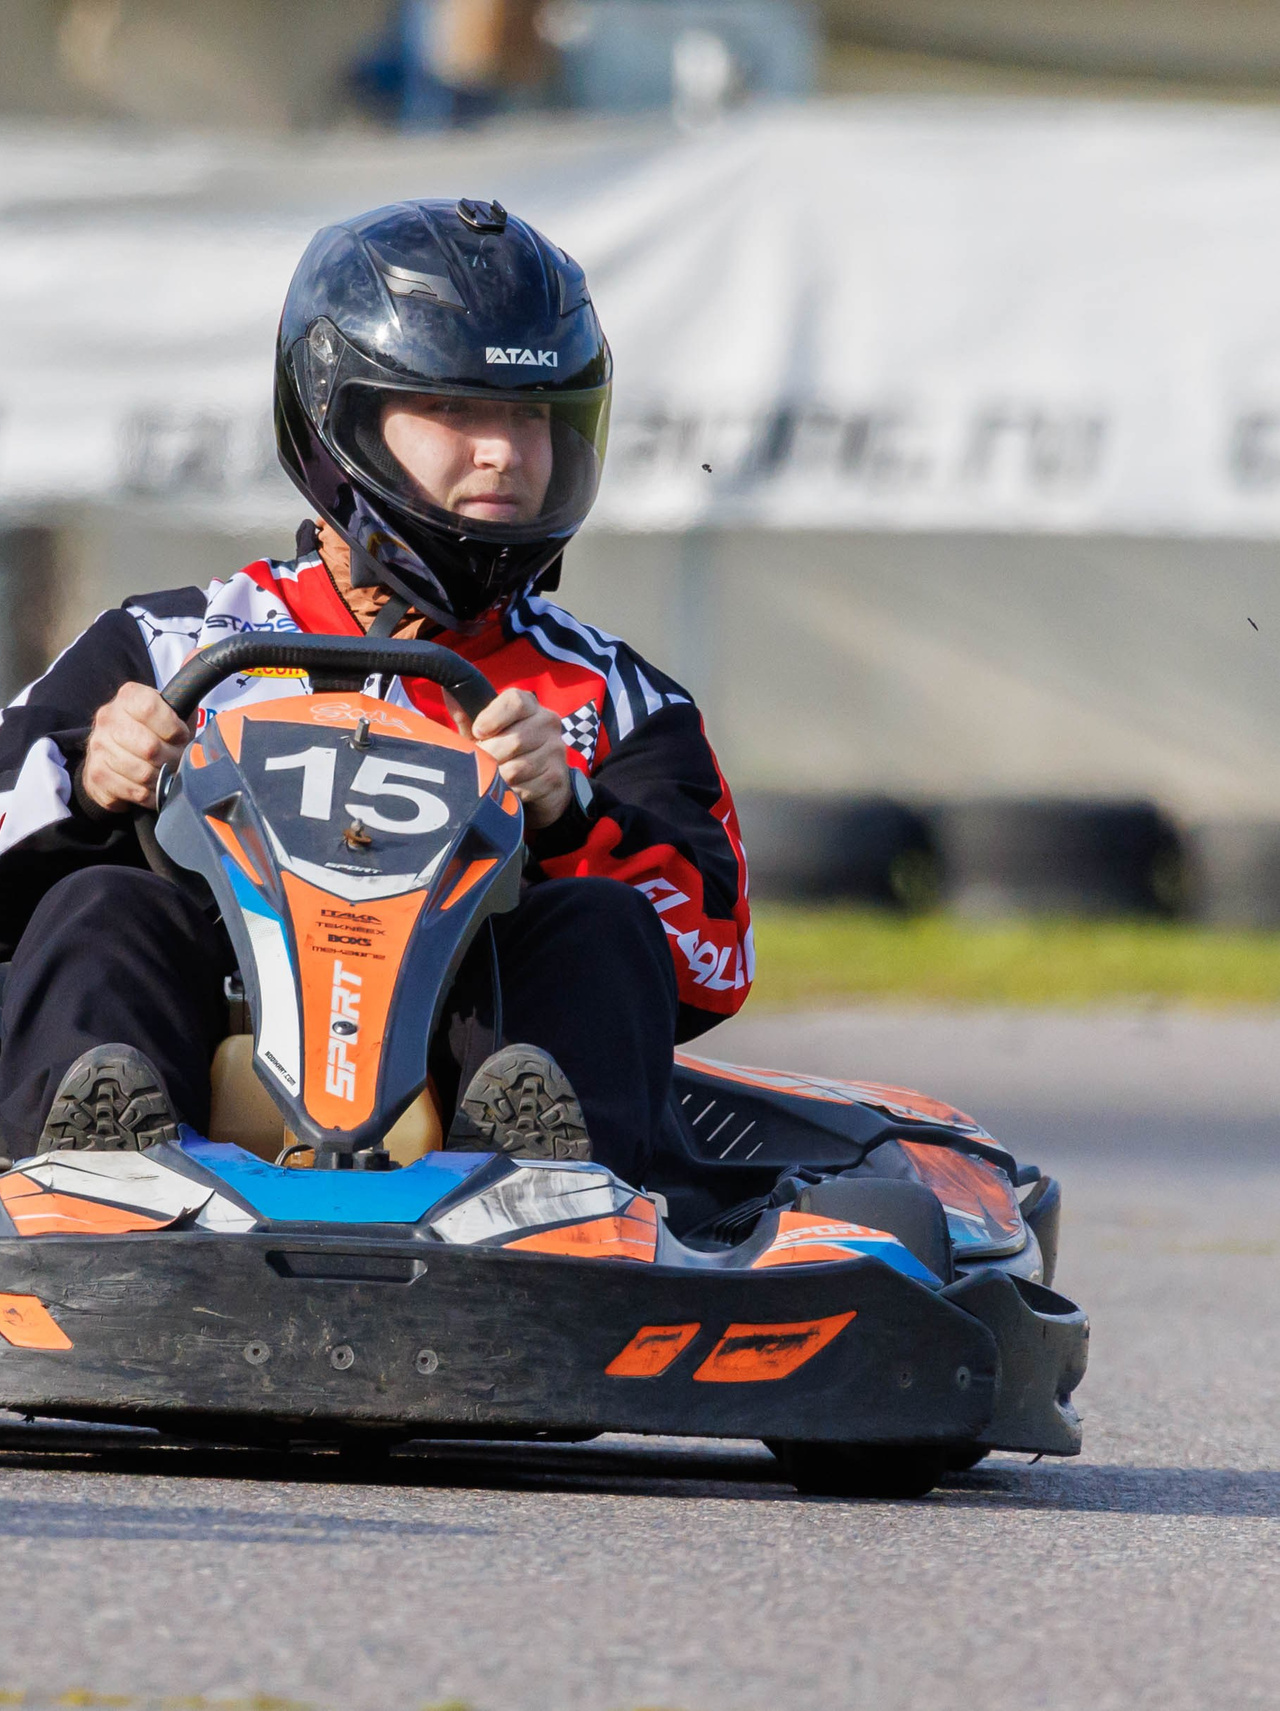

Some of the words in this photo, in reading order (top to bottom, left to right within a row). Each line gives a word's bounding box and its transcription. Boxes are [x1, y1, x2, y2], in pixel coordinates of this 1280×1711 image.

[485, 346, 558, 368] ATAKI
[264, 745, 450, 835] 15
[323, 861, 384, 875] SPORT
[325, 959, 363, 1103] SPORT
